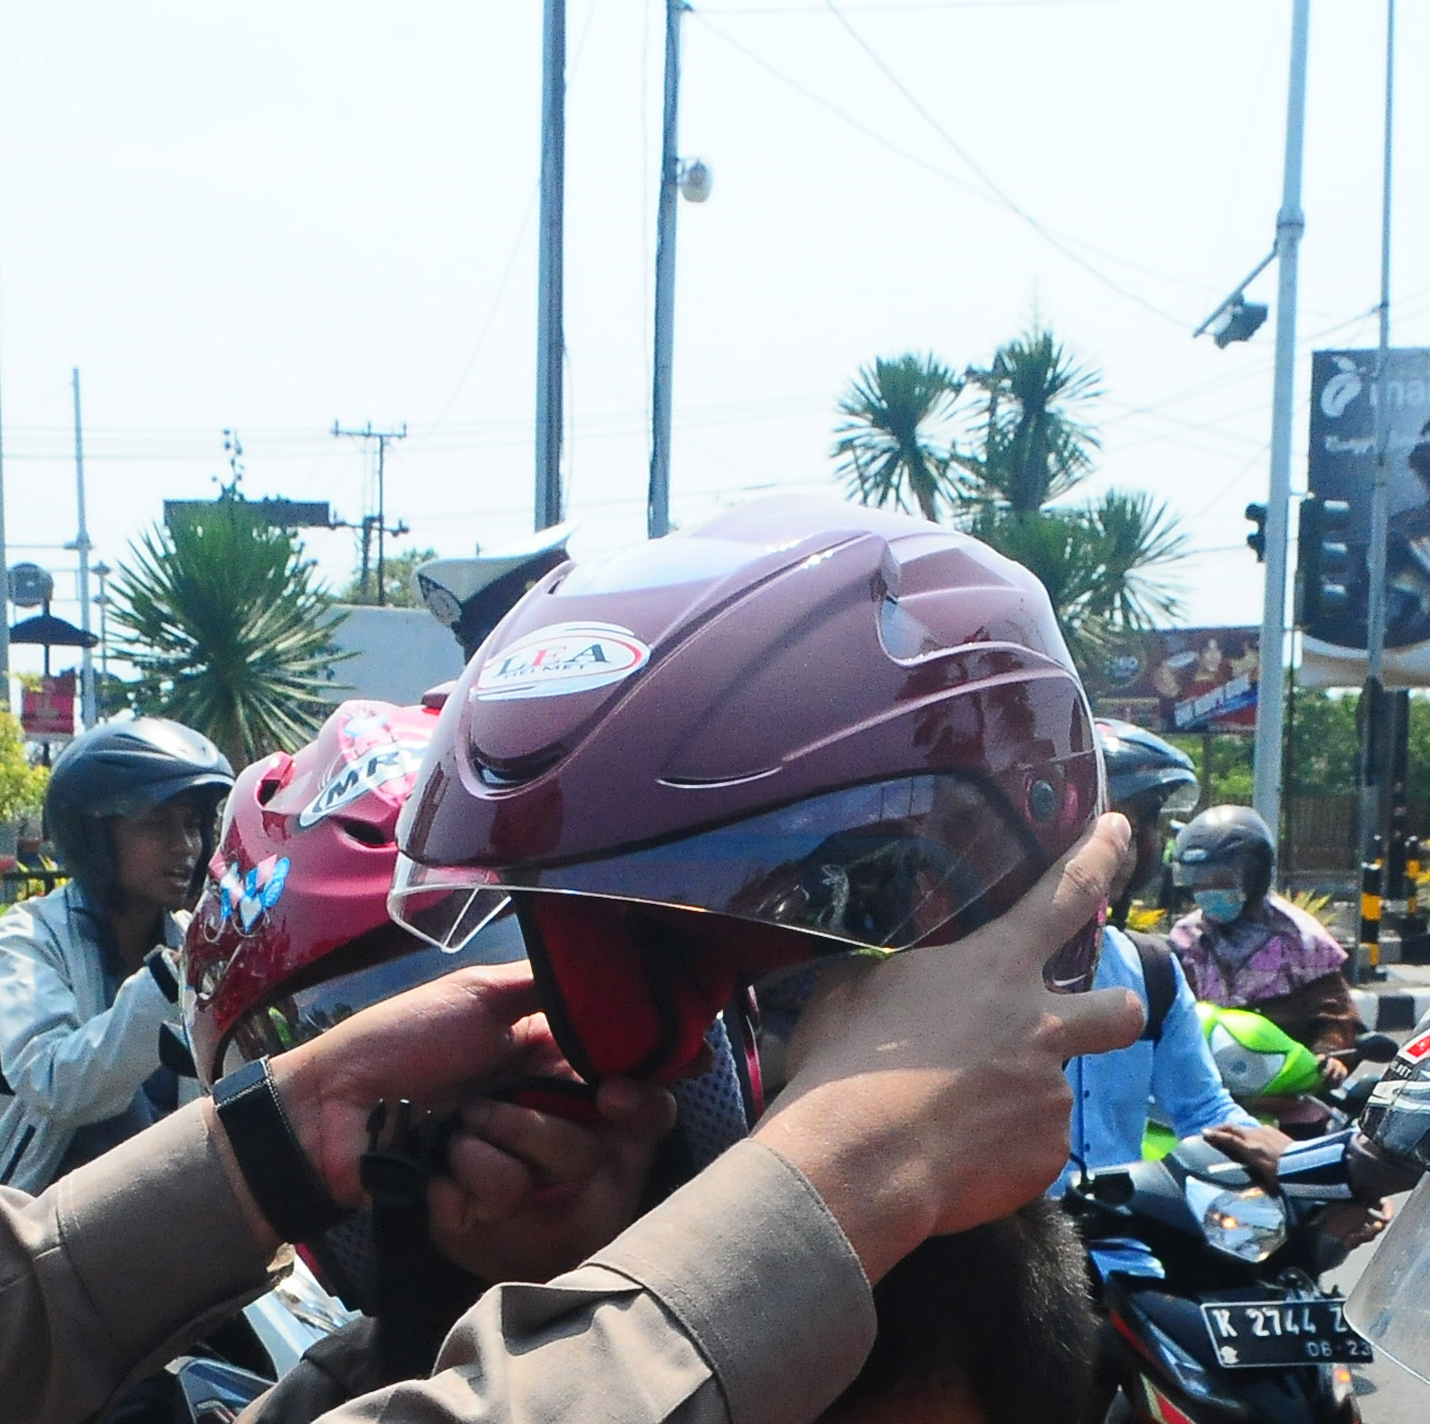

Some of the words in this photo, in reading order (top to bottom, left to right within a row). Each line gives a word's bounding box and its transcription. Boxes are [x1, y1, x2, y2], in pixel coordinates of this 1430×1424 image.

[493, 643, 610, 678] LEA
[1212, 1308, 1238, 1337] K
[1245, 1306, 1316, 1336] 2744
